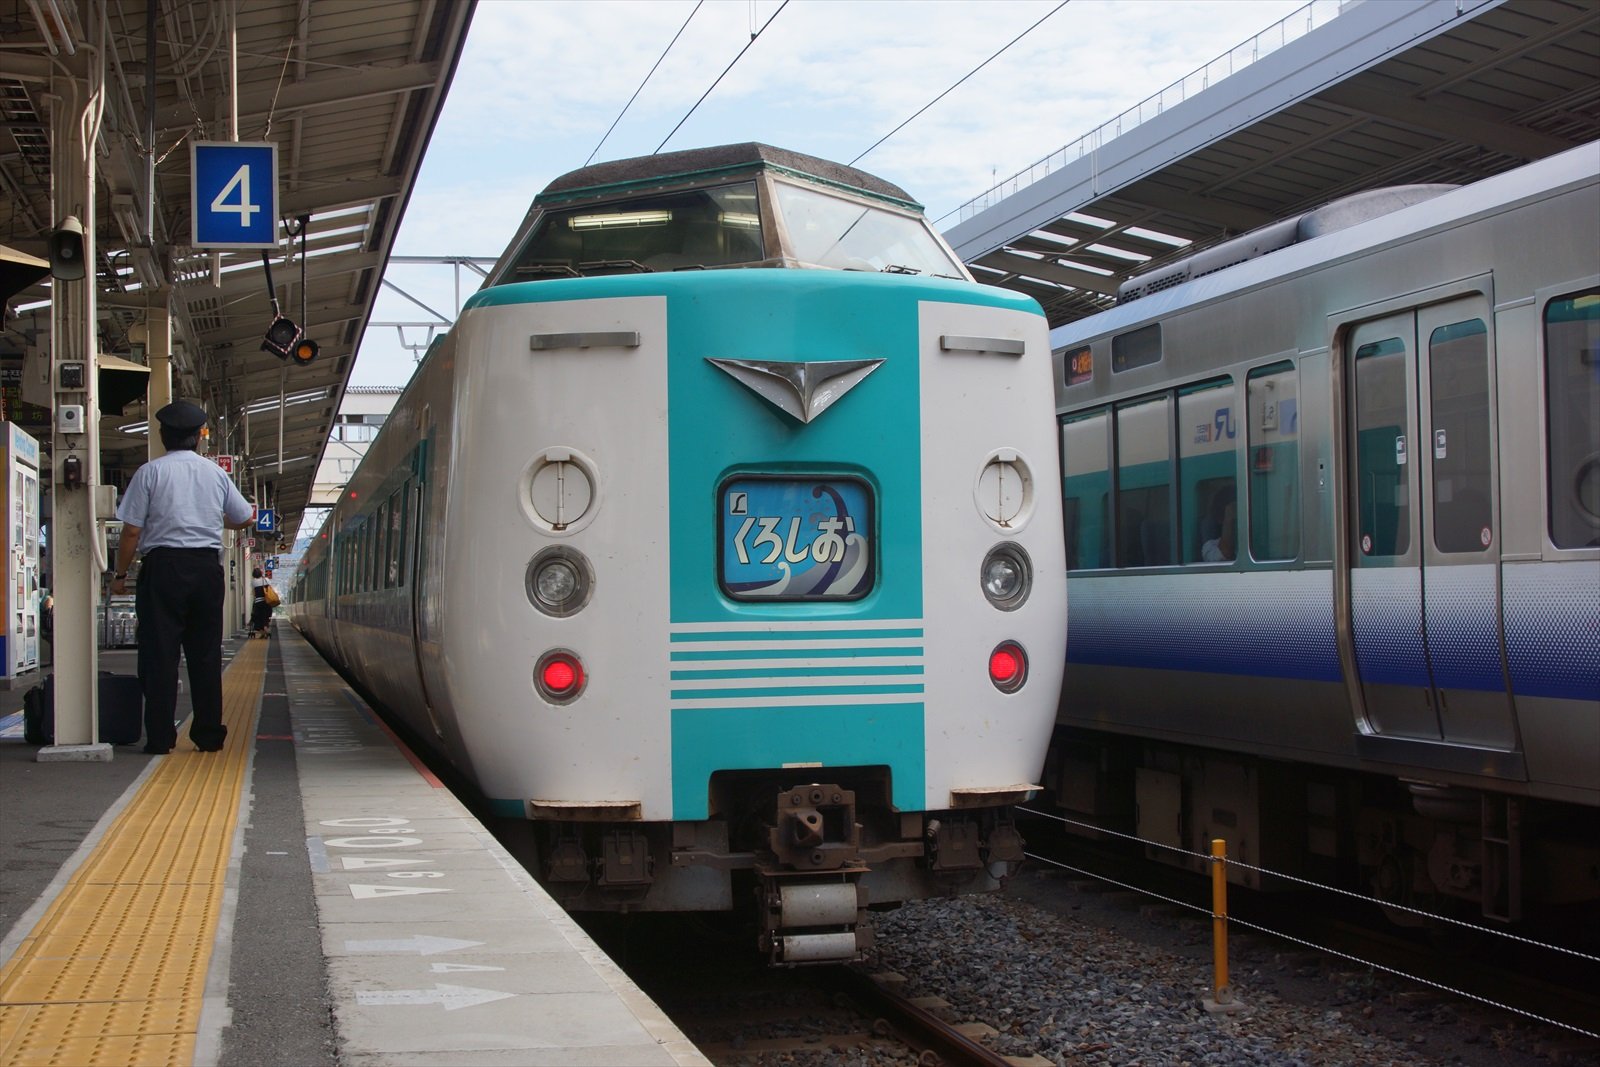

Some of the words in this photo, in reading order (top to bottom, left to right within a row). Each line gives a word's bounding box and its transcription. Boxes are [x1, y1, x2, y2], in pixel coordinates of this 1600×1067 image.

[211, 165, 260, 227] 4
[260, 513, 271, 527] 4
[734, 517, 855, 564] くろしお
[267, 560, 274, 569] 4
